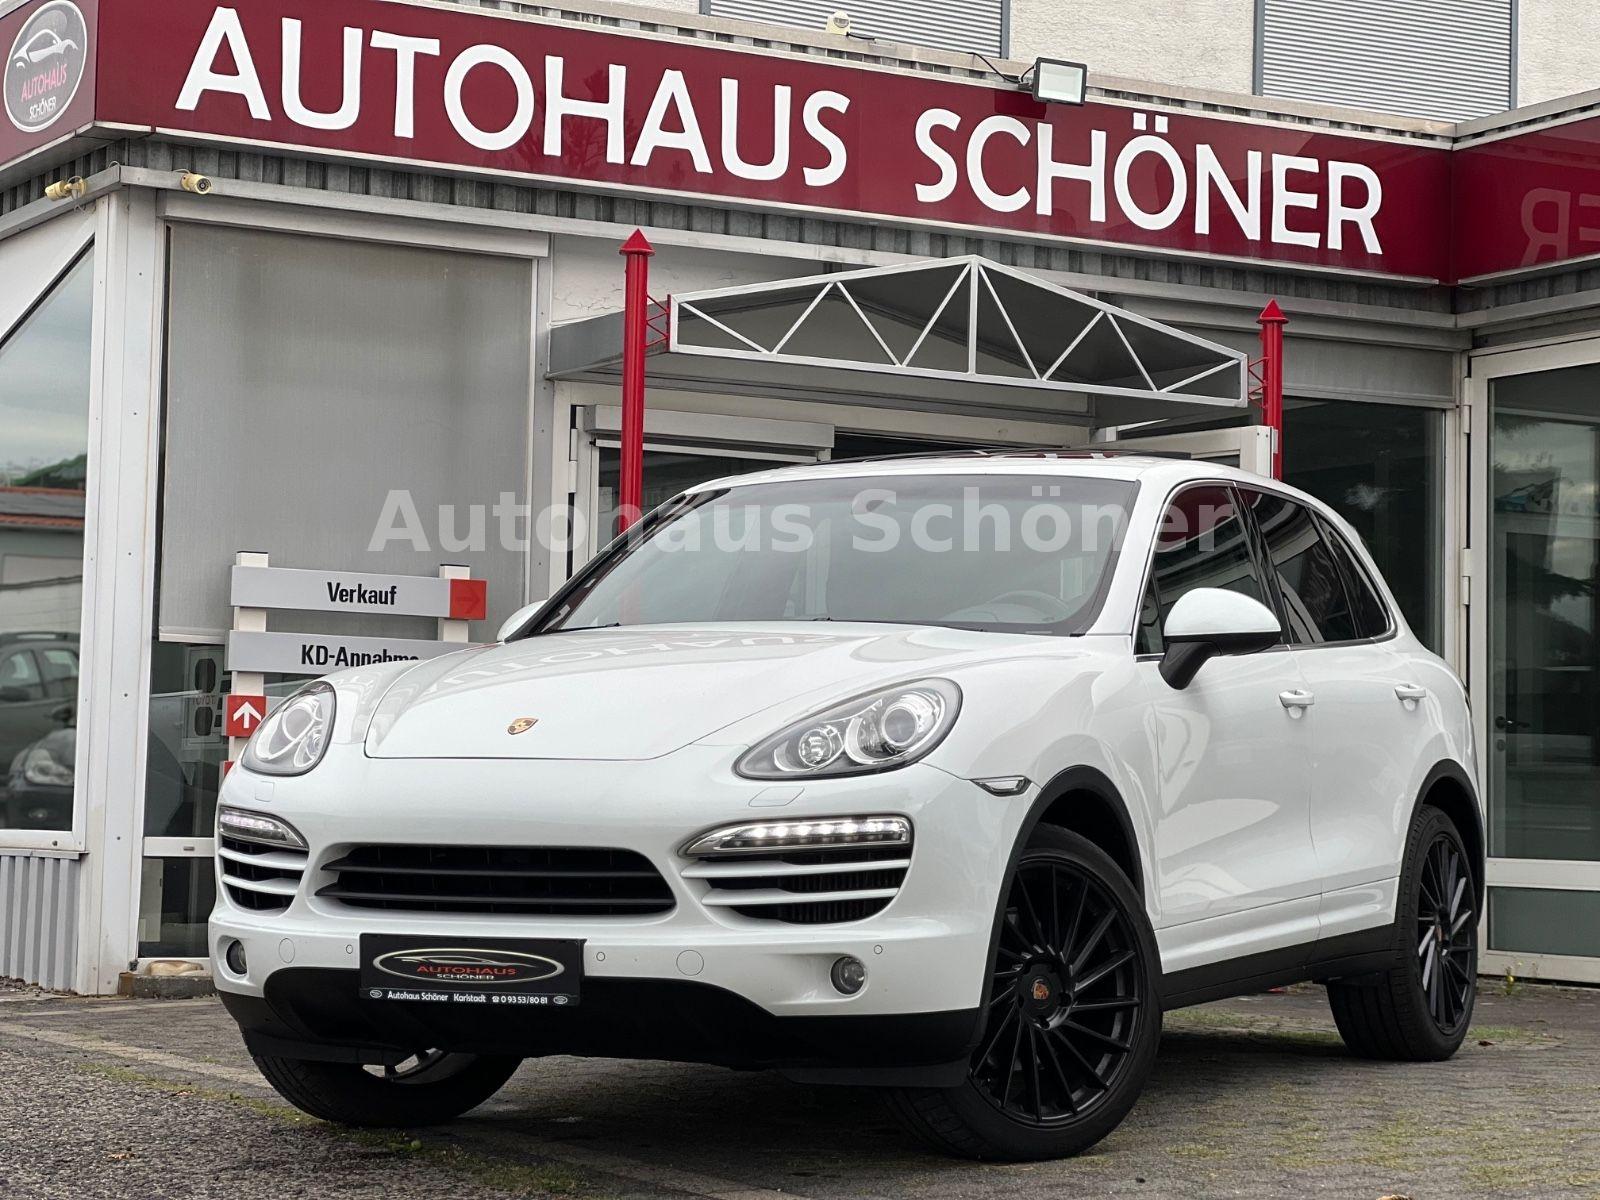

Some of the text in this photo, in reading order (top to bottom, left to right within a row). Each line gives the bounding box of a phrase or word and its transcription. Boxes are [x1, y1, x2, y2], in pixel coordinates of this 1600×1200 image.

[21, 63, 67, 102] AUTOHAUS
[29, 96, 57, 119] SCHÖNER
[175, 6, 850, 188] AUTOHAUS
[914, 112, 1383, 256] SCHÖNER
[327, 581, 397, 606] Verkauf
[416, 965, 517, 975] AUTOHAUS
[387, 990, 420, 1000] Autohaus
[421, 992, 448, 1001] Schöner
[453, 993, 487, 1003] Karlstadt
